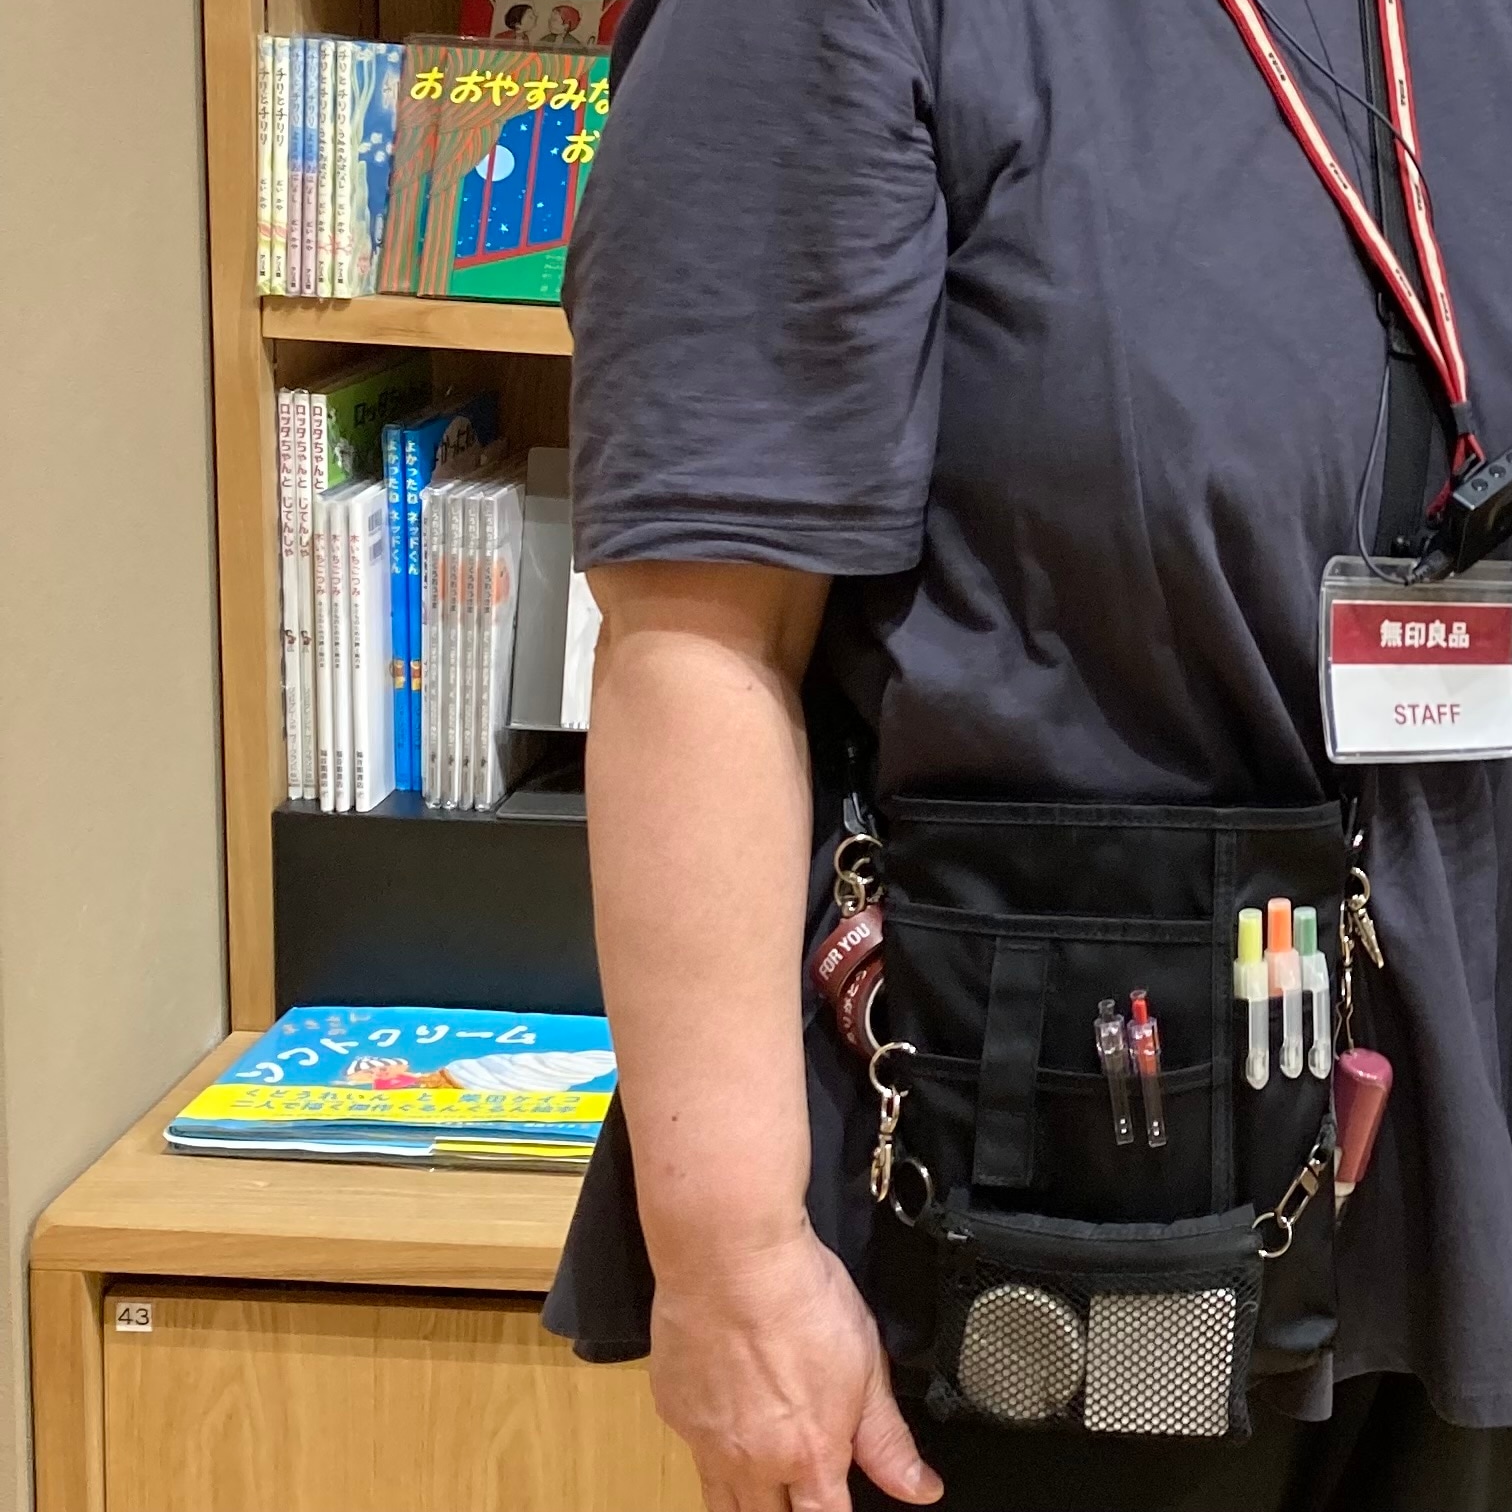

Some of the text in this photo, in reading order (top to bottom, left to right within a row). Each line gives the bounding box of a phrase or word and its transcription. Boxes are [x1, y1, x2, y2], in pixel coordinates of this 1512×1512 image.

[258, 66, 270, 146] チリとチリリ
[275, 67, 287, 147] チリとチリリ
[280, 402, 295, 558] ロッタちゃんと じてんしゃ
[295, 403, 311, 559] ロッタちゃんと じてんしゃ
[312, 404, 326, 490] ロッタちゃんと
[387, 440, 402, 576] よかったね ネッドくん
[405, 439, 421, 576] よかったね ネッドくん
[331, 533, 342, 597] 木いちごつみ
[349, 533, 361, 597] 木いちごつみ
[1380, 618, 1470, 649] 無印良品
[1394, 703, 1461, 726] STAFF
[818, 948, 844, 981] FOR
[837, 922, 871, 952] YOU
[236, 1023, 538, 1084] ソフトクリーム
[117, 1308, 151, 1326] 43
